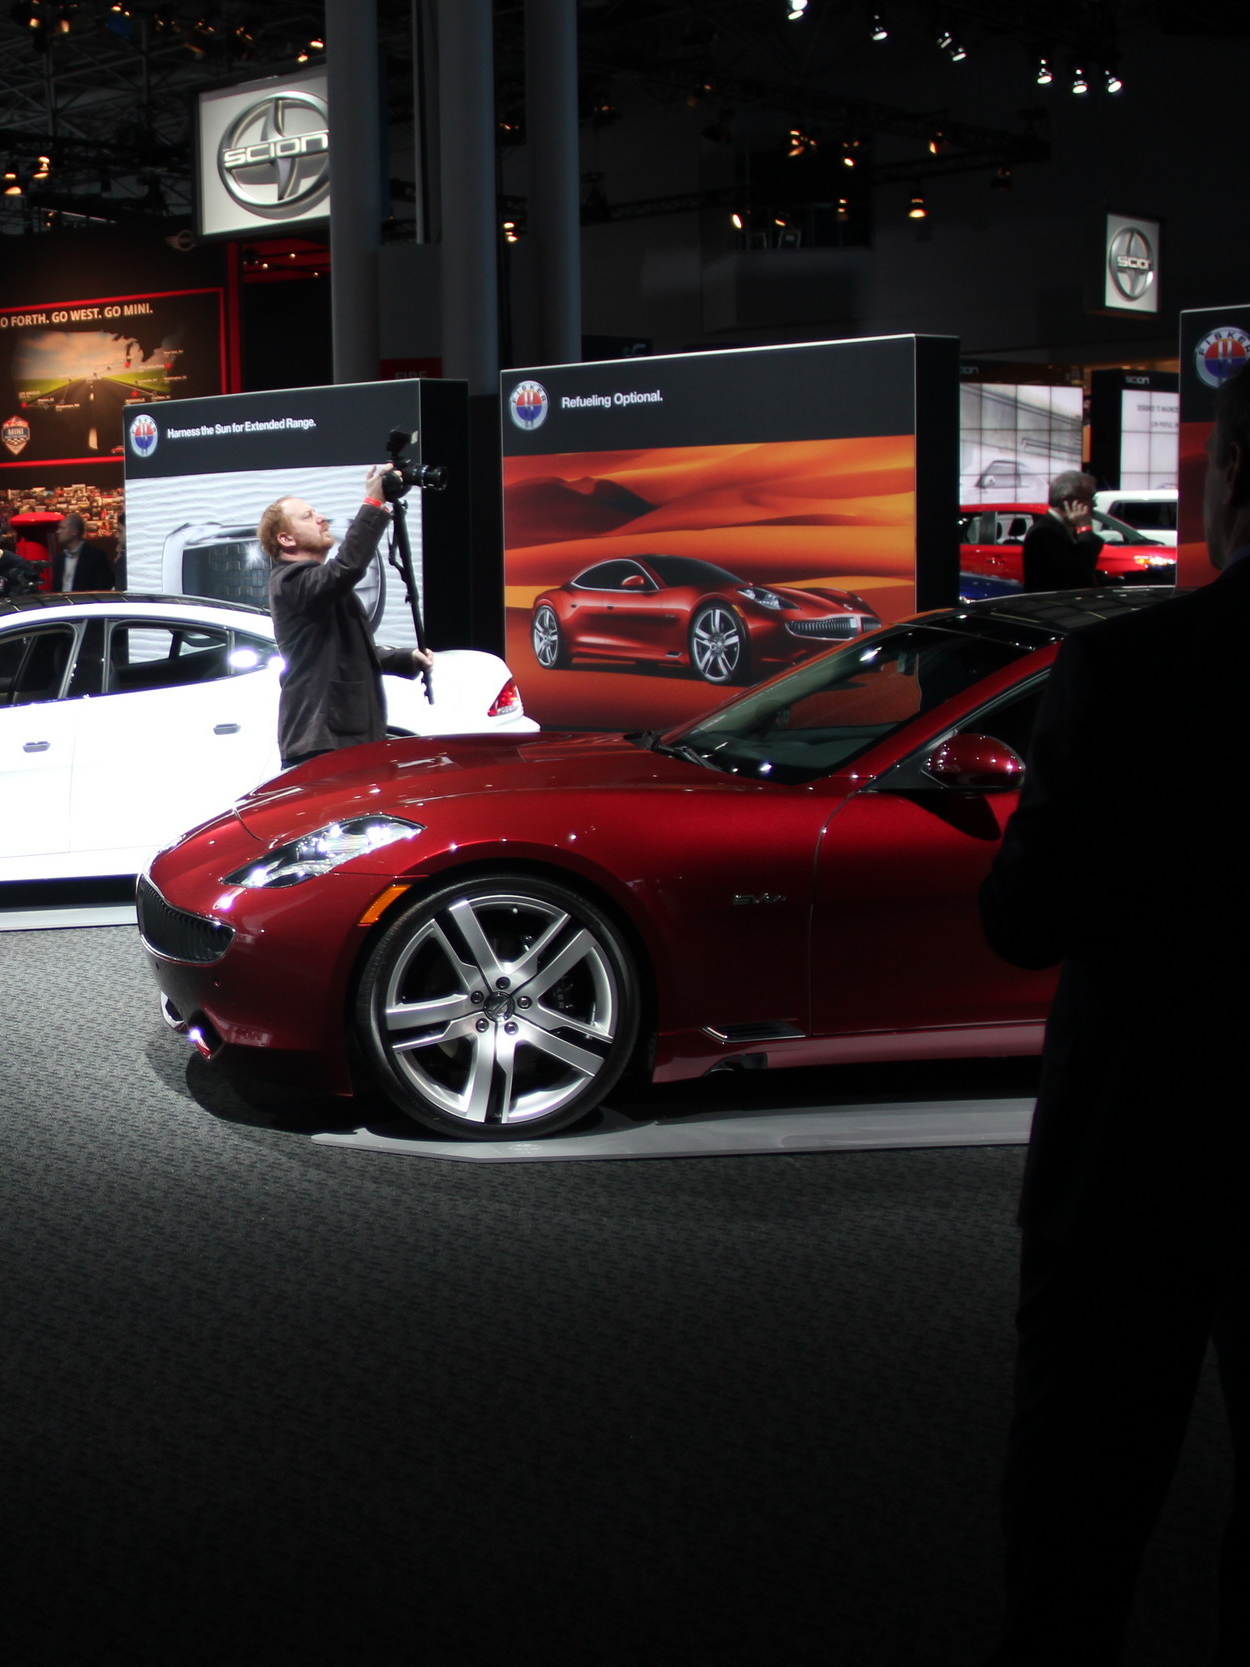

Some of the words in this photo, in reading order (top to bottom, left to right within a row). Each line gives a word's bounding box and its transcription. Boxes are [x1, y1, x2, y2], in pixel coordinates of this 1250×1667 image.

[11, 313, 50, 327] FORTH.
[51, 310, 69, 323] GO
[70, 307, 102, 321] WEST.
[104, 305, 122, 319] GO
[124, 302, 154, 316] MINI.
[562, 394, 612, 409] Refueling
[614, 389, 663, 406] Optional.
[167, 428, 201, 439] Harness
[201, 425, 214, 436] the
[215, 423, 231, 435] Sun
[232, 421, 244, 433] for
[245, 418, 285, 432] Extended
[286, 417, 317, 430] Range.
